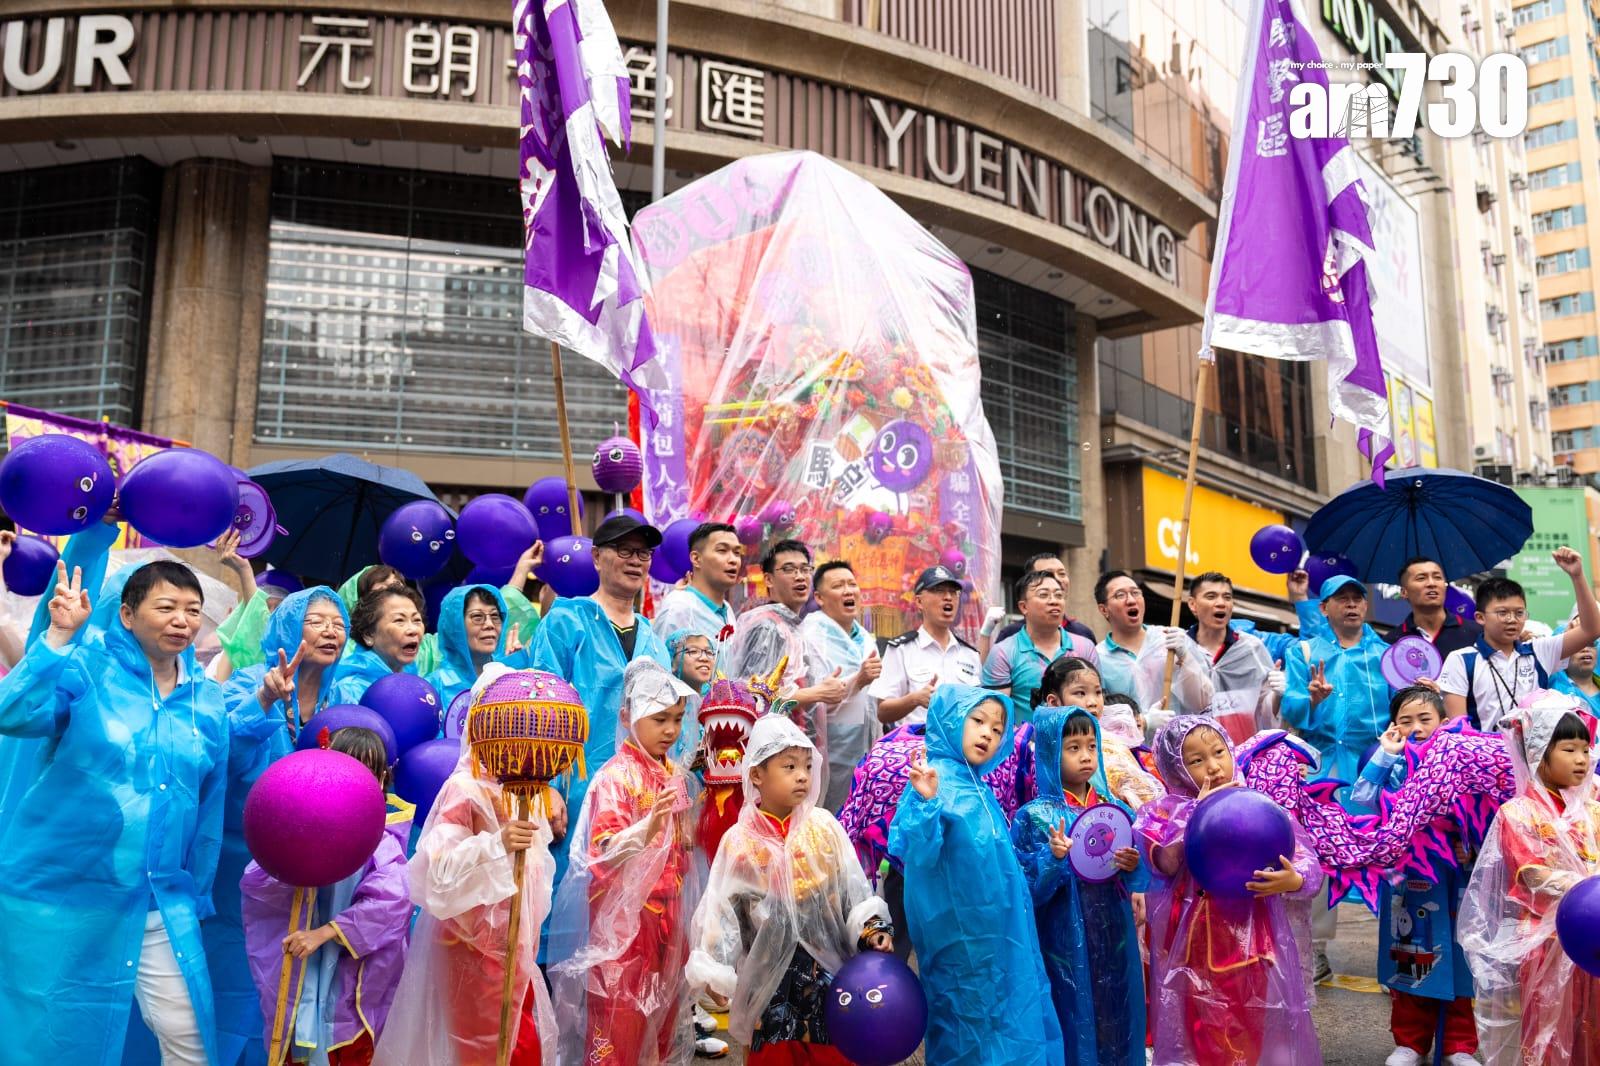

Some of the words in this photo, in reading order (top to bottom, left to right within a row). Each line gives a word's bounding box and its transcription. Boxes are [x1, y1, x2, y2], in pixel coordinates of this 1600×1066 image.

[3, 15, 134, 91] UR
[297, 16, 764, 137] 元朗色匯
[868, 98, 1046, 220] YUEN
[1059, 166, 1179, 287] LONG
